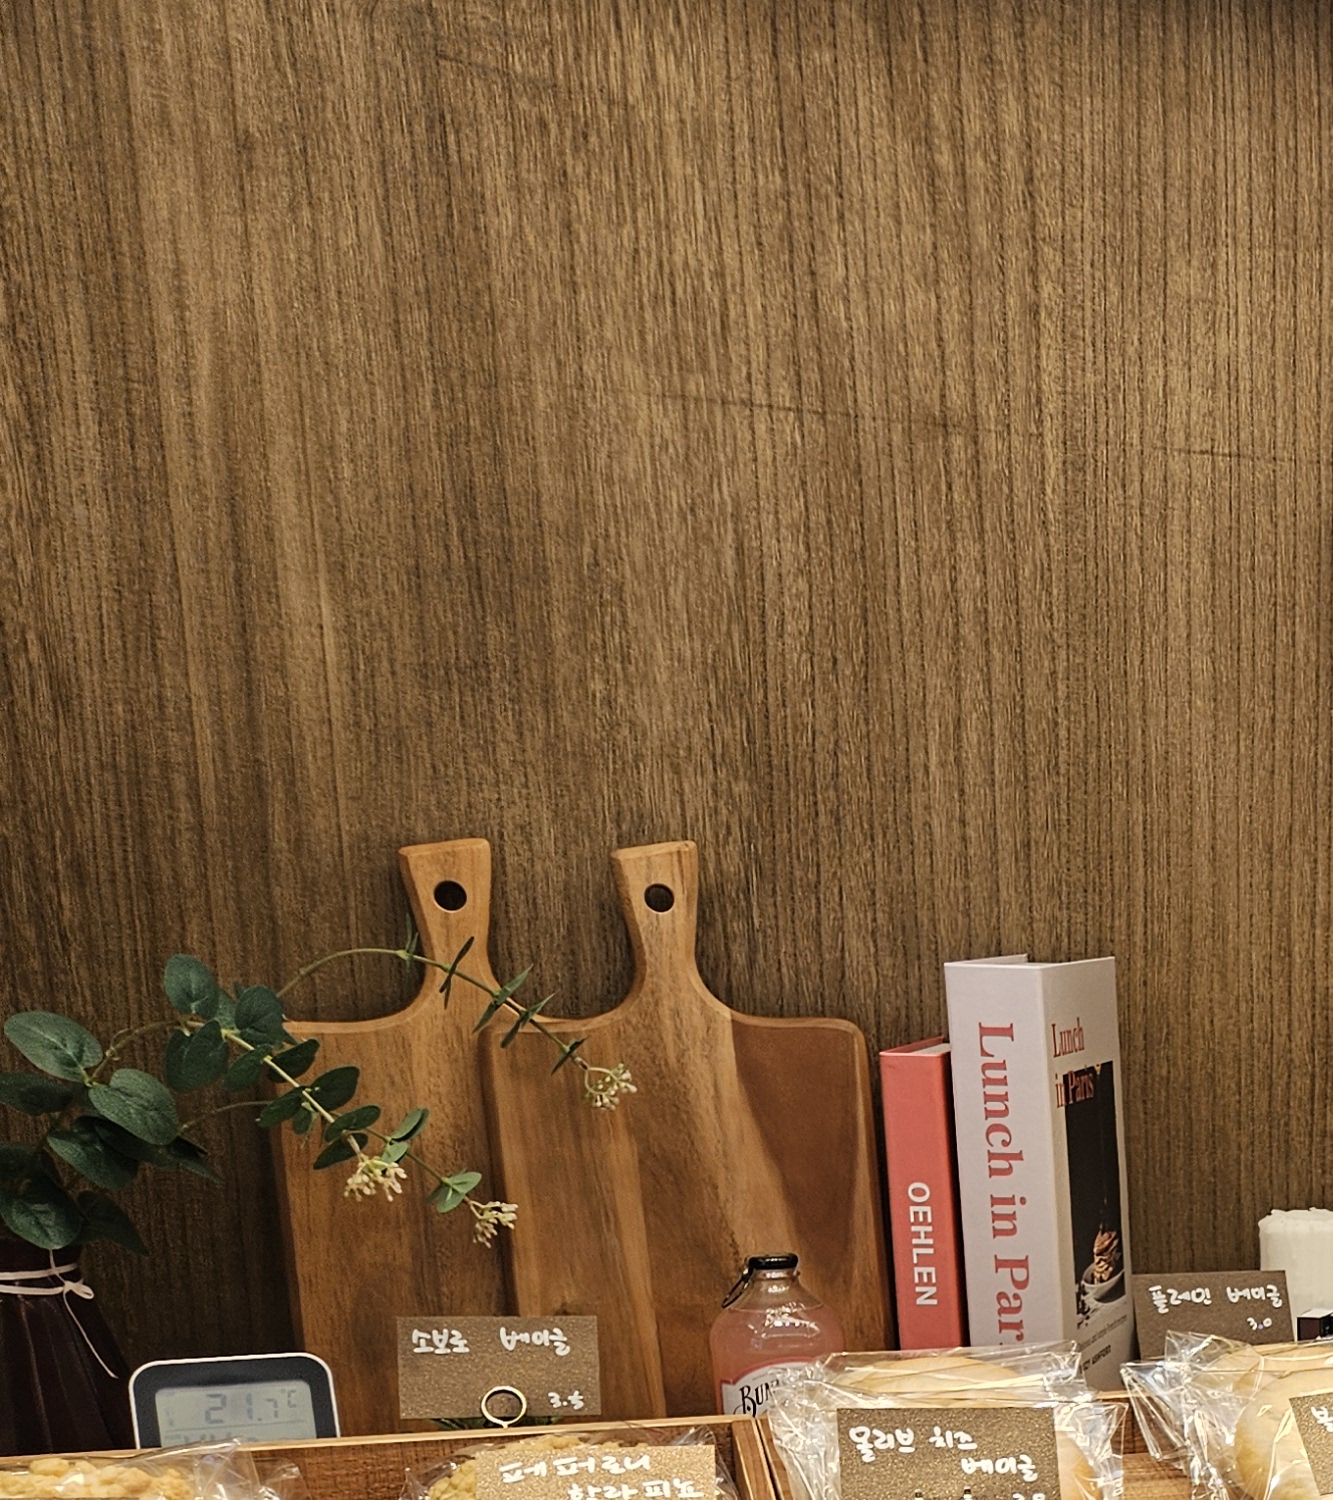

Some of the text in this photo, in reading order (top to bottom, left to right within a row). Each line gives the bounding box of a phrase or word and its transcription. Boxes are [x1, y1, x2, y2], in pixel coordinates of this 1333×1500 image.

[1051, 1017, 1085, 1058] Lunch
[1055, 1065, 1094, 1108] in Paris
[977, 1021, 1030, 1345] Lunch in Par
[907, 1180, 939, 1307] OEHLEN
[1148, 1283, 1284, 1315] 플레인 베이글
[411, 1325, 571, 1356] 소보로 베이글
[1246, 1315, 1273, 1331] 3.0
[547, 1389, 585, 1411] 3.5
[848, 1425, 979, 1464] 올리브 치즈
[960, 1454, 1039, 1483] 베이글
